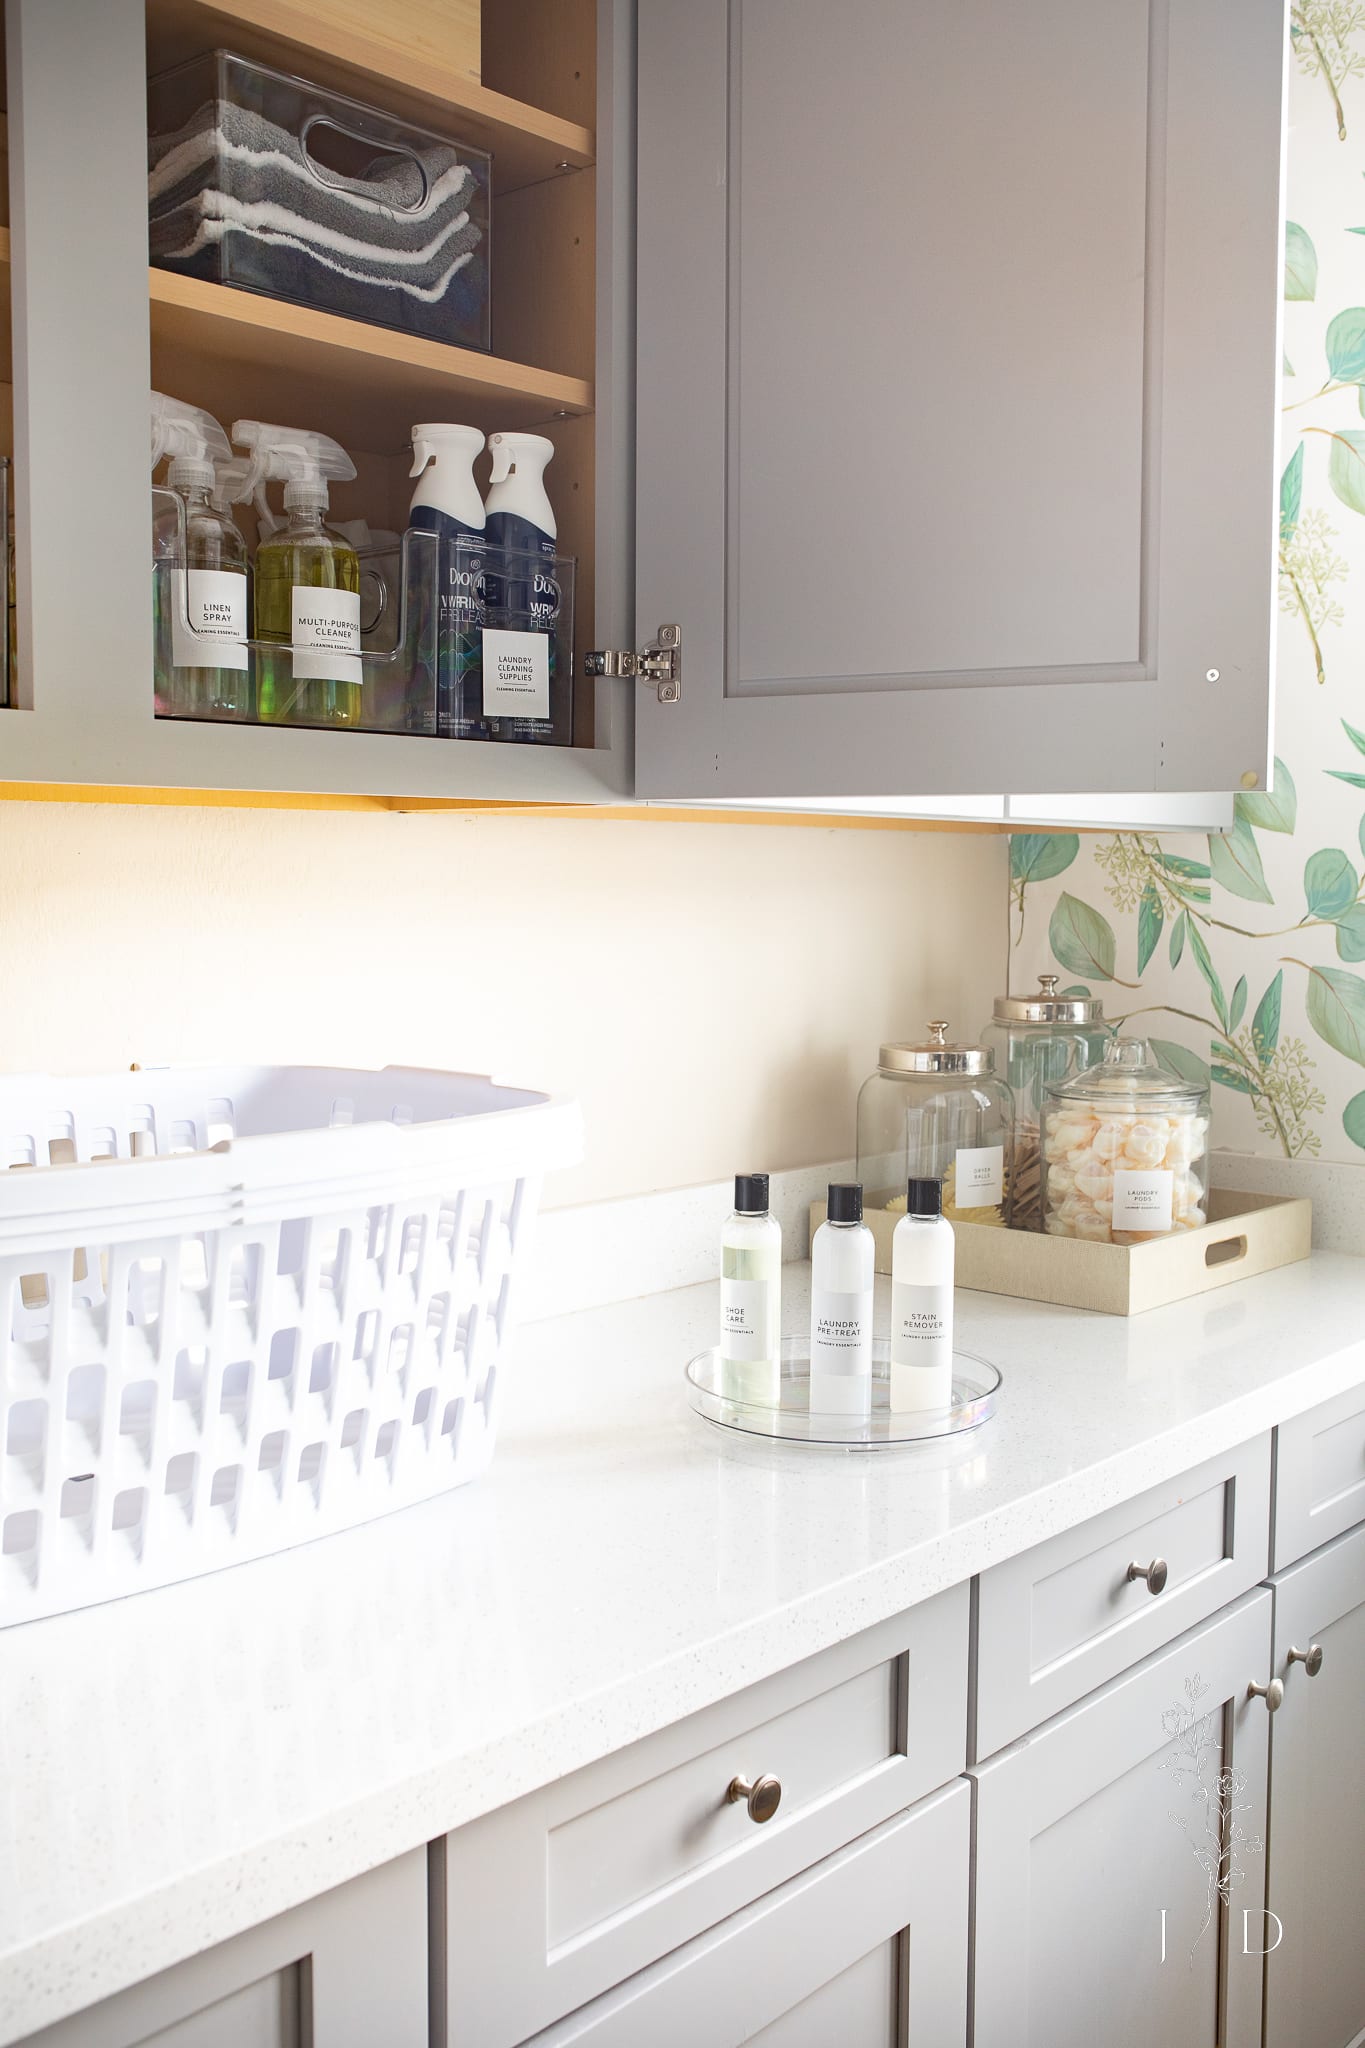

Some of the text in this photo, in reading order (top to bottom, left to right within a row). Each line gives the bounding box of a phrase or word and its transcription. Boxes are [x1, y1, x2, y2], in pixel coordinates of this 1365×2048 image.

[203, 603, 231, 612] LINEN
[203, 613, 232, 622] SPRAY
[298, 617, 359, 632] MULTI-PURPOSE
[315, 628, 352, 639] CLEANER
[498, 655, 532, 664] LAUNDRY
[497, 664, 533, 673] CLEANING
[499, 673, 532, 682] SUPPLIES
[725, 1306, 745, 1316] SHOE
[726, 1314, 745, 1324] CARE
[911, 1313, 937, 1321] STAIN
[819, 1318, 859, 1328] LAUNDRY
[903, 1320, 943, 1329] REMOVER
[817, 1326, 861, 1337] PRE-TREAT
